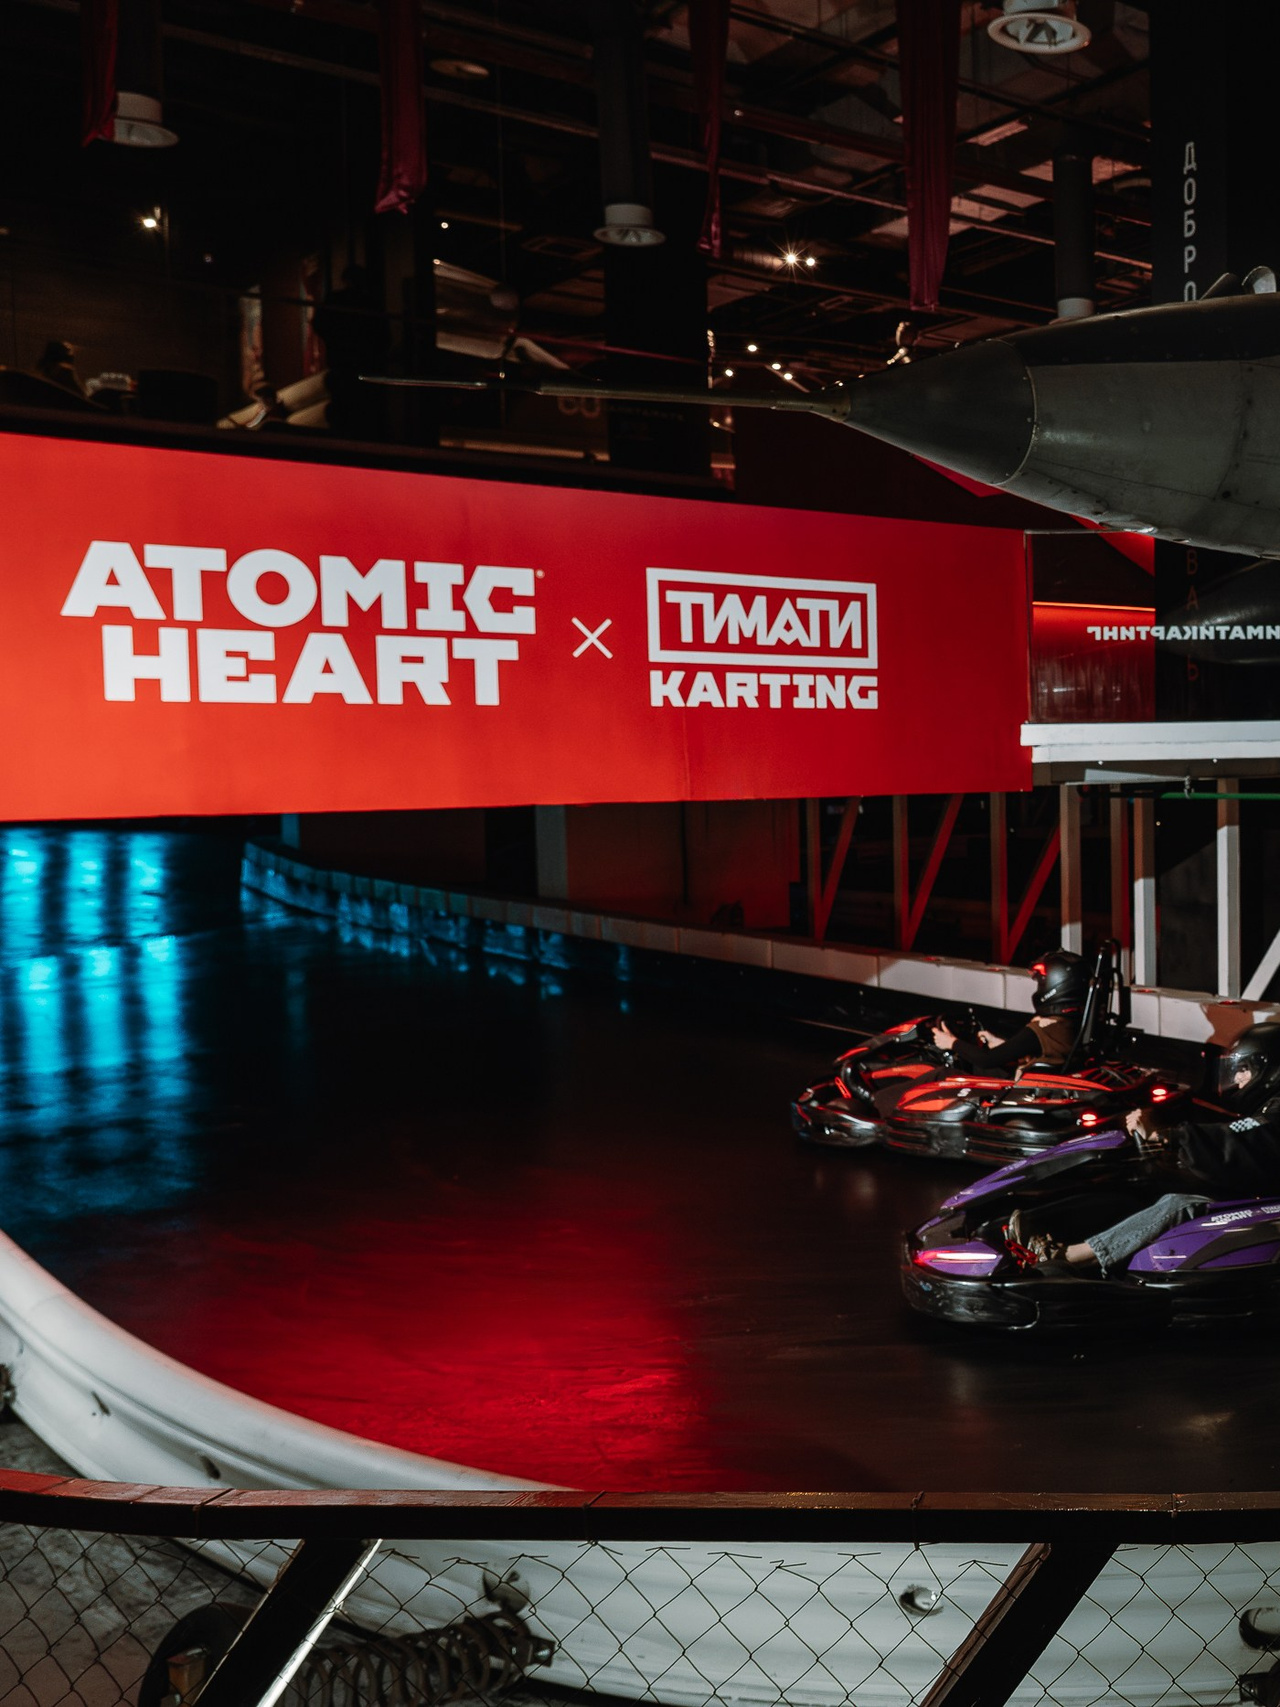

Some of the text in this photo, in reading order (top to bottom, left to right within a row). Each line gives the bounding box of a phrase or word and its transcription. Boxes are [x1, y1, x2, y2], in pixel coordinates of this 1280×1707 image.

[1182, 141, 1198, 302] ДОБРО
[60, 540, 537, 634] ATOMIC
[101, 625, 519, 706] HEART
[649, 670, 879, 710] KARTING
